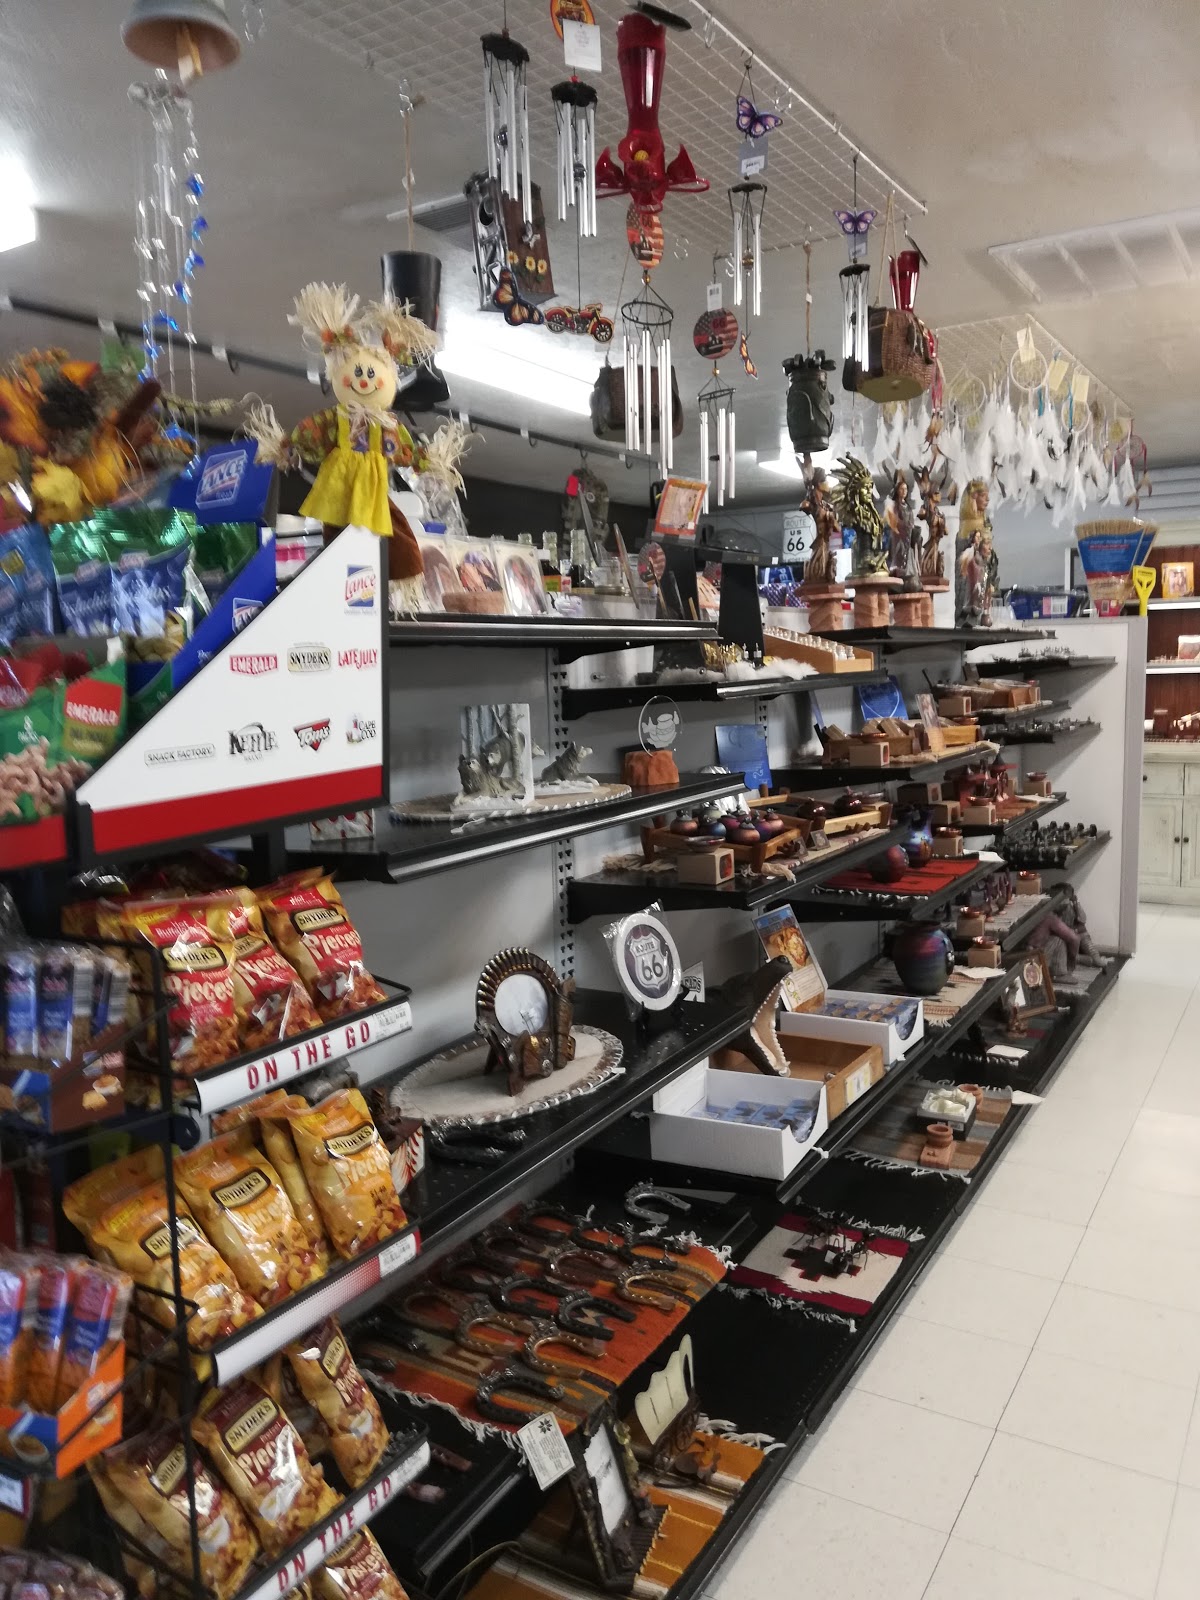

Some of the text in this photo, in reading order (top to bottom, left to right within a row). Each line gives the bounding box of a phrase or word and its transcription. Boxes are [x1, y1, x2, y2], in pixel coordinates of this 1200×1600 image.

[787, 537, 805, 552] 66
[344, 573, 377, 602] Lance
[231, 655, 278, 675] EMERALD
[338, 649, 378, 670] LATE JULY
[147, 746, 212, 762] SNACK FACTORY
[246, 1056, 278, 1090] ON
[291, 1035, 332, 1071] THE
[345, 1020, 370, 1049] GO
[331, 1128, 372, 1149] SNYDER'S
[220, 1175, 261, 1202] SNYDER'S
[229, 1401, 272, 1444] SNYDER'S
[277, 1550, 306, 1592] ON
[318, 1506, 354, 1552] THE
[368, 1477, 391, 1511] GO
